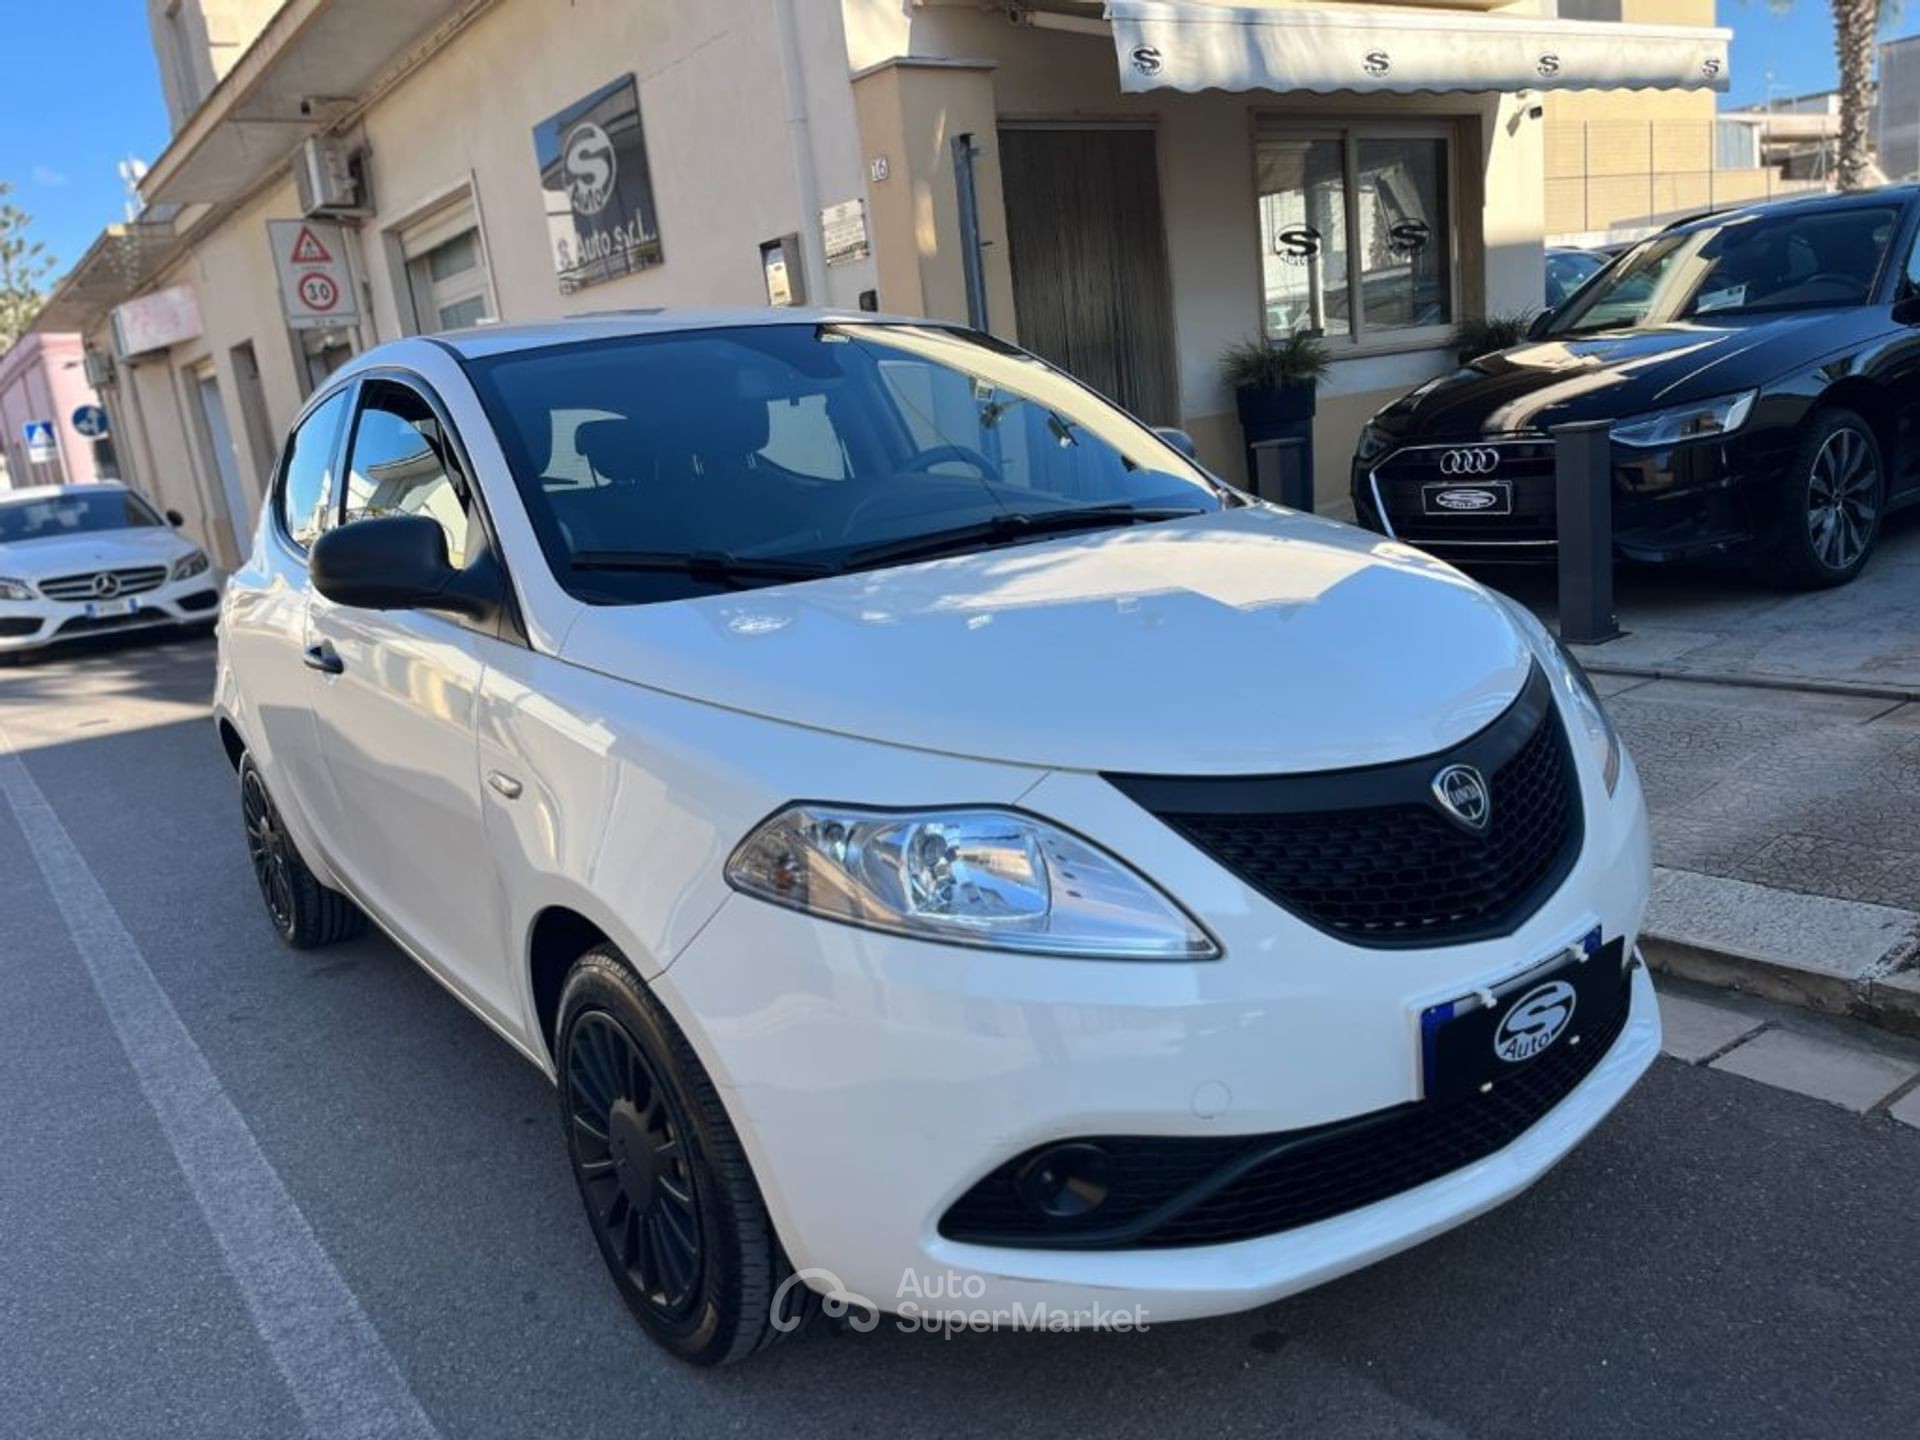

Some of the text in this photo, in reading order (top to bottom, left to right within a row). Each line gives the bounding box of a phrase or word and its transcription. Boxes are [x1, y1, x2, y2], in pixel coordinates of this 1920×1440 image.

[574, 229, 611, 263] Auto
[307, 282, 330, 301] 30
[1504, 1033, 1550, 1058] Auto
